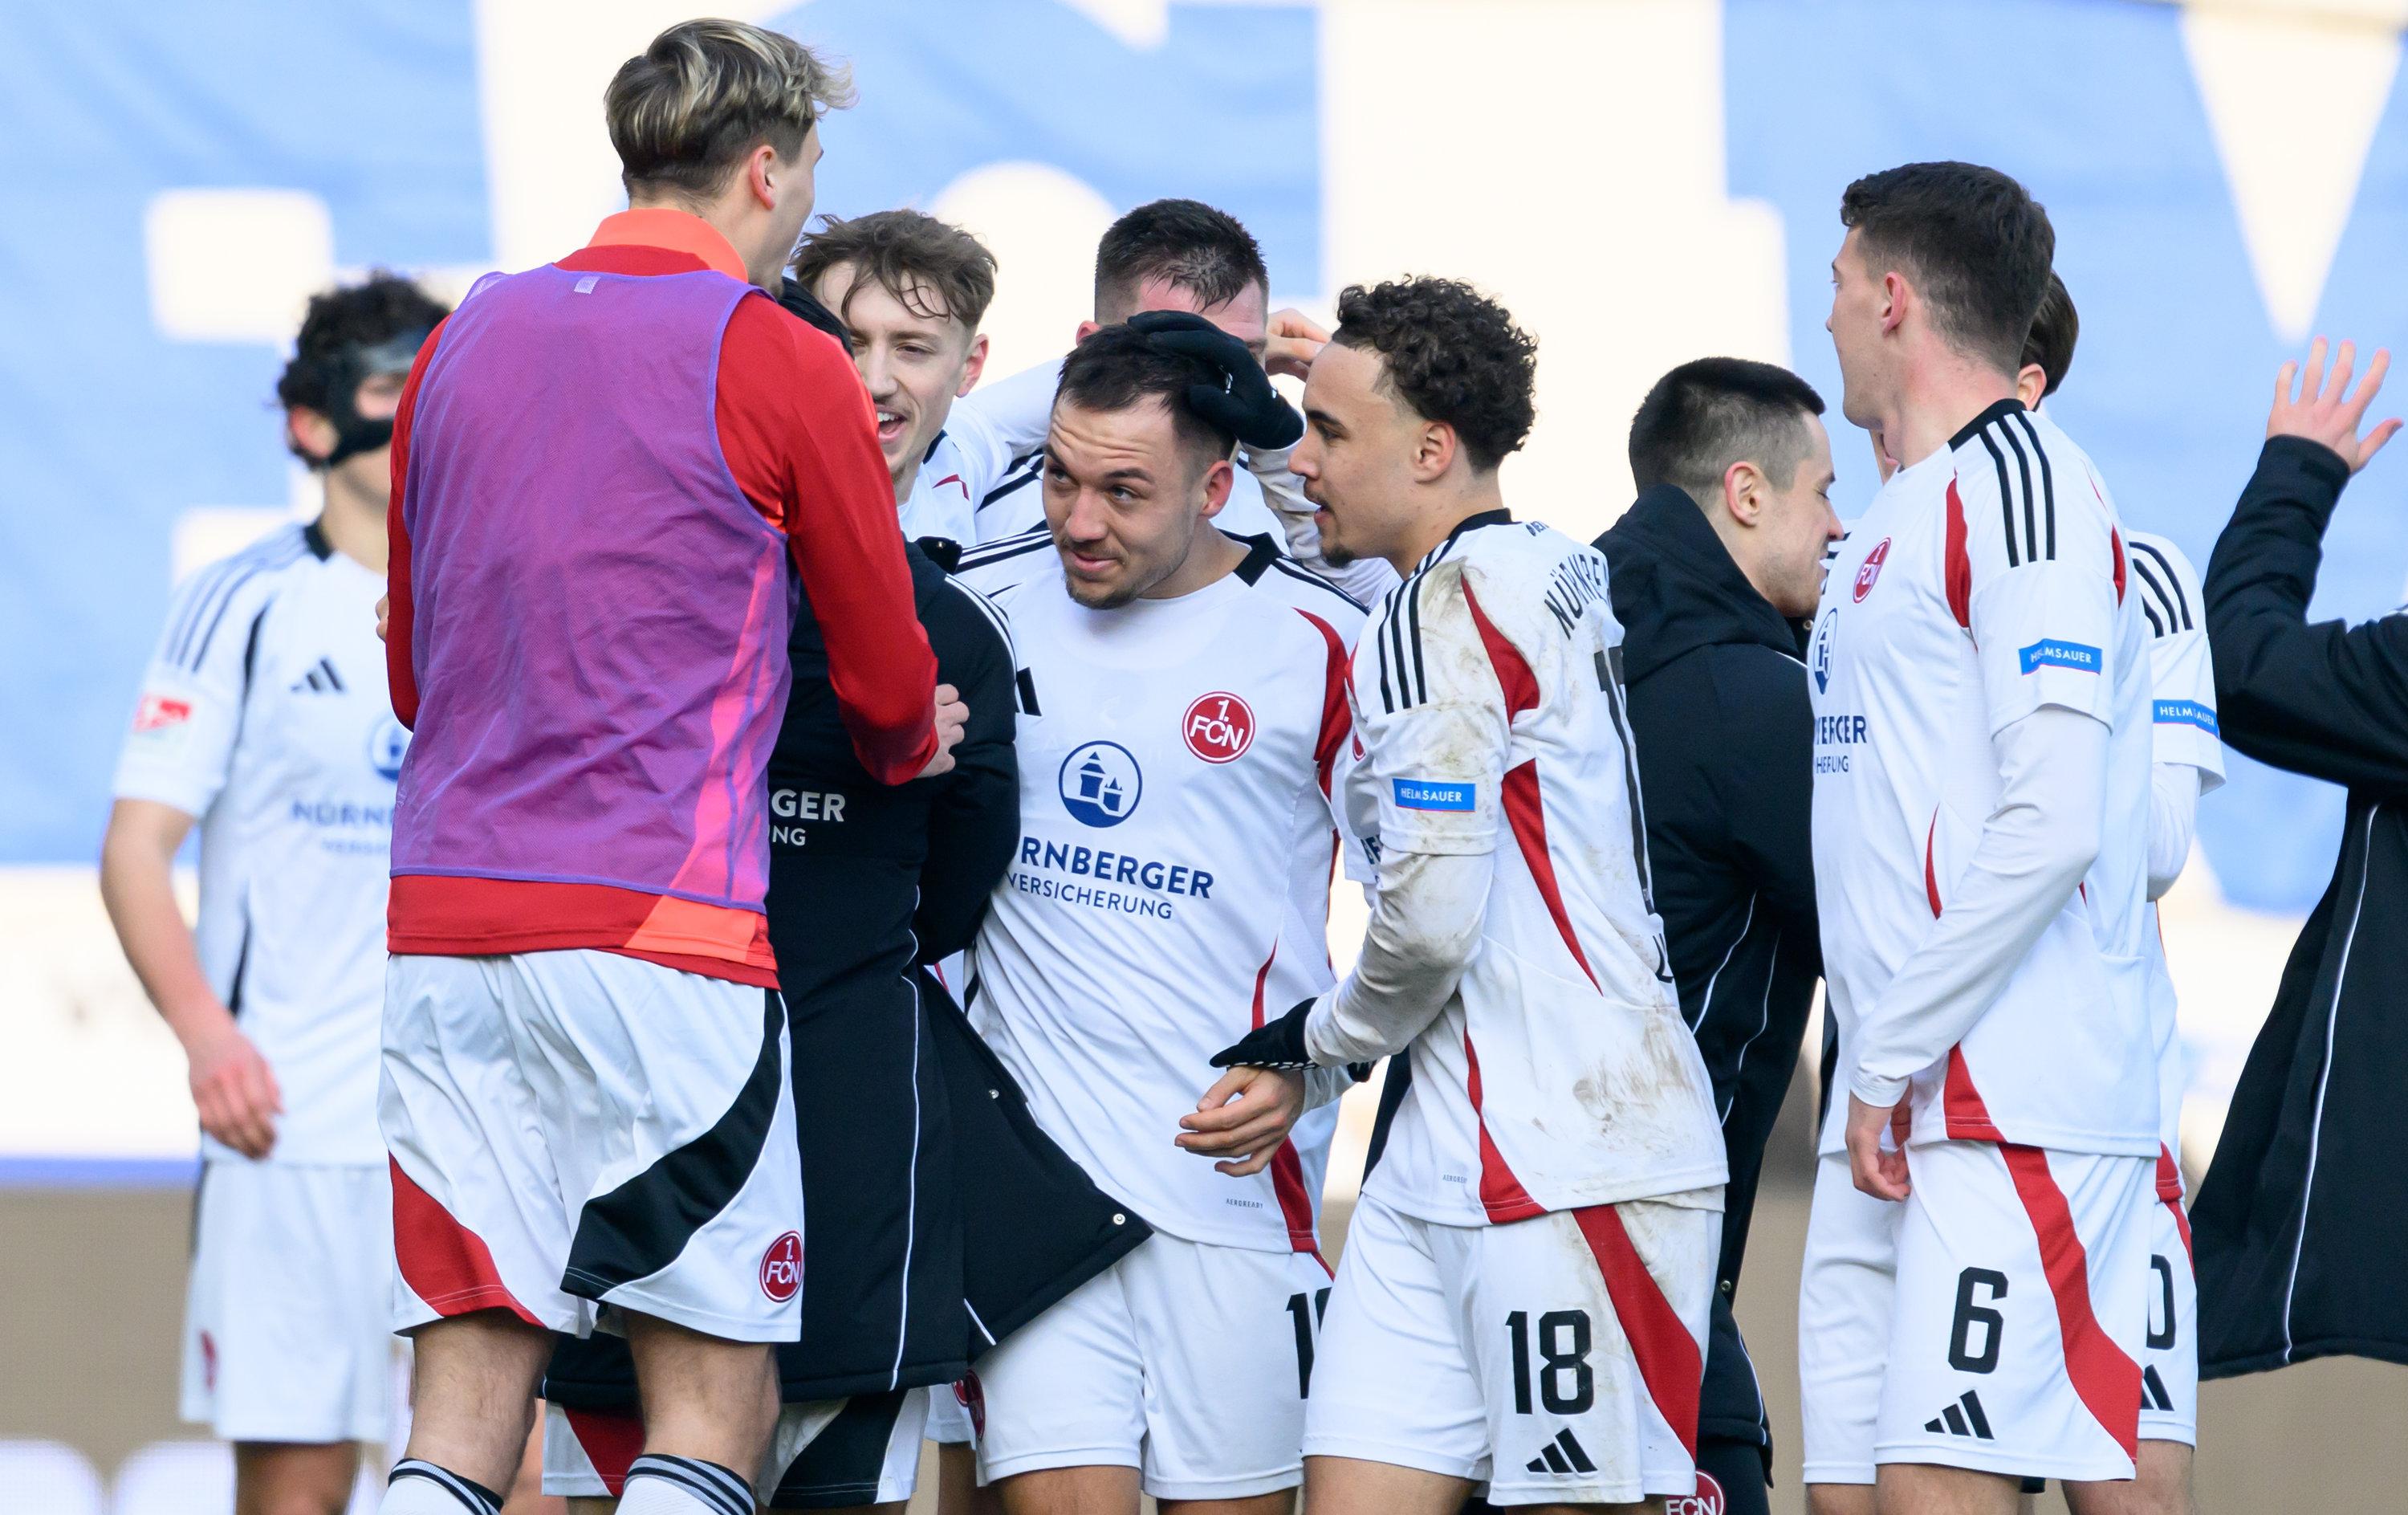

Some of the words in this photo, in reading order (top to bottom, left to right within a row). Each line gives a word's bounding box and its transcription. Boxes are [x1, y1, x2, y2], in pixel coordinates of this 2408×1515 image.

[1189, 715, 1245, 751] FCN
[771, 788, 847, 823] GER
[1400, 787, 1463, 803] HELMSAUER
[771, 825, 807, 847] NG
[1020, 836, 1214, 899] RNBERGER
[1006, 871, 1173, 920] VERSICHERUNG
[765, 1260, 801, 1285] FCN
[1947, 1265, 2010, 1375] 6
[1285, 1286, 1333, 1400] 1
[1504, 1309, 1595, 1415] 18
